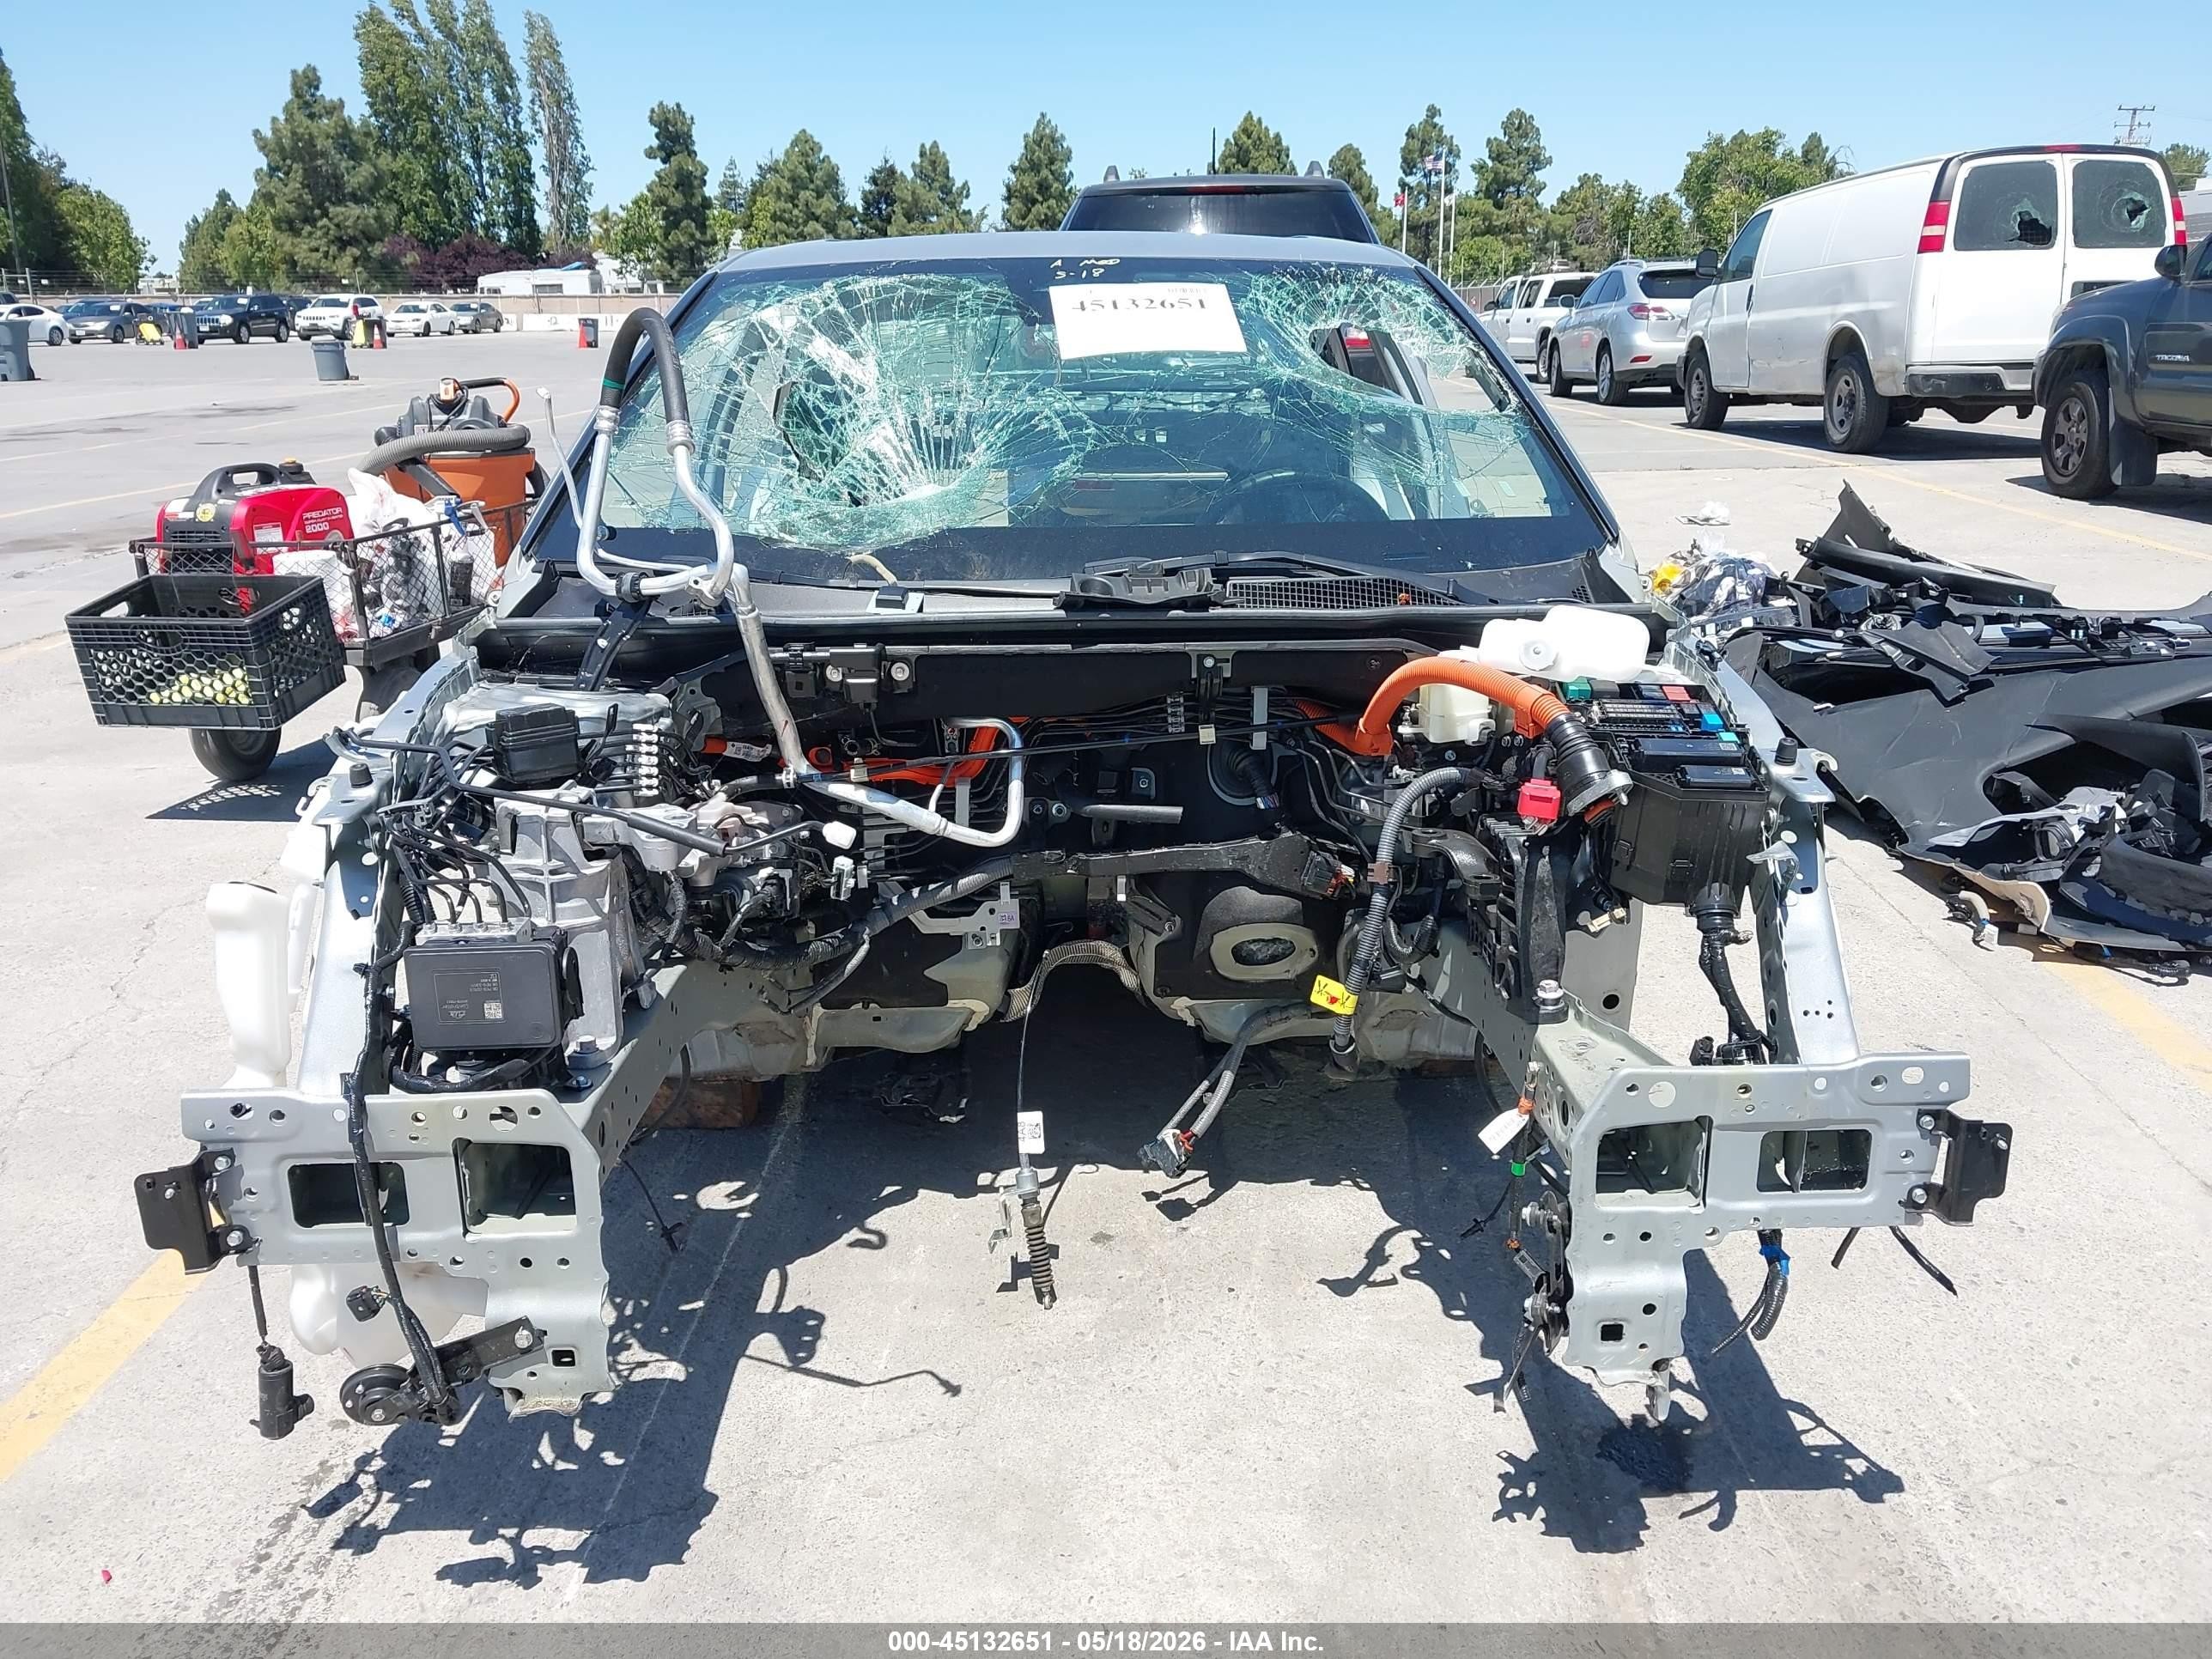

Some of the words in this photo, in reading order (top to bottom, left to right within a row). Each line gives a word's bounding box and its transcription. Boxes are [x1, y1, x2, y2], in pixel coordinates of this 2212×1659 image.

[1072, 298, 1206, 312] 45132651
[302, 507, 343, 520] PREDATOR
[305, 521, 330, 533] 2000
